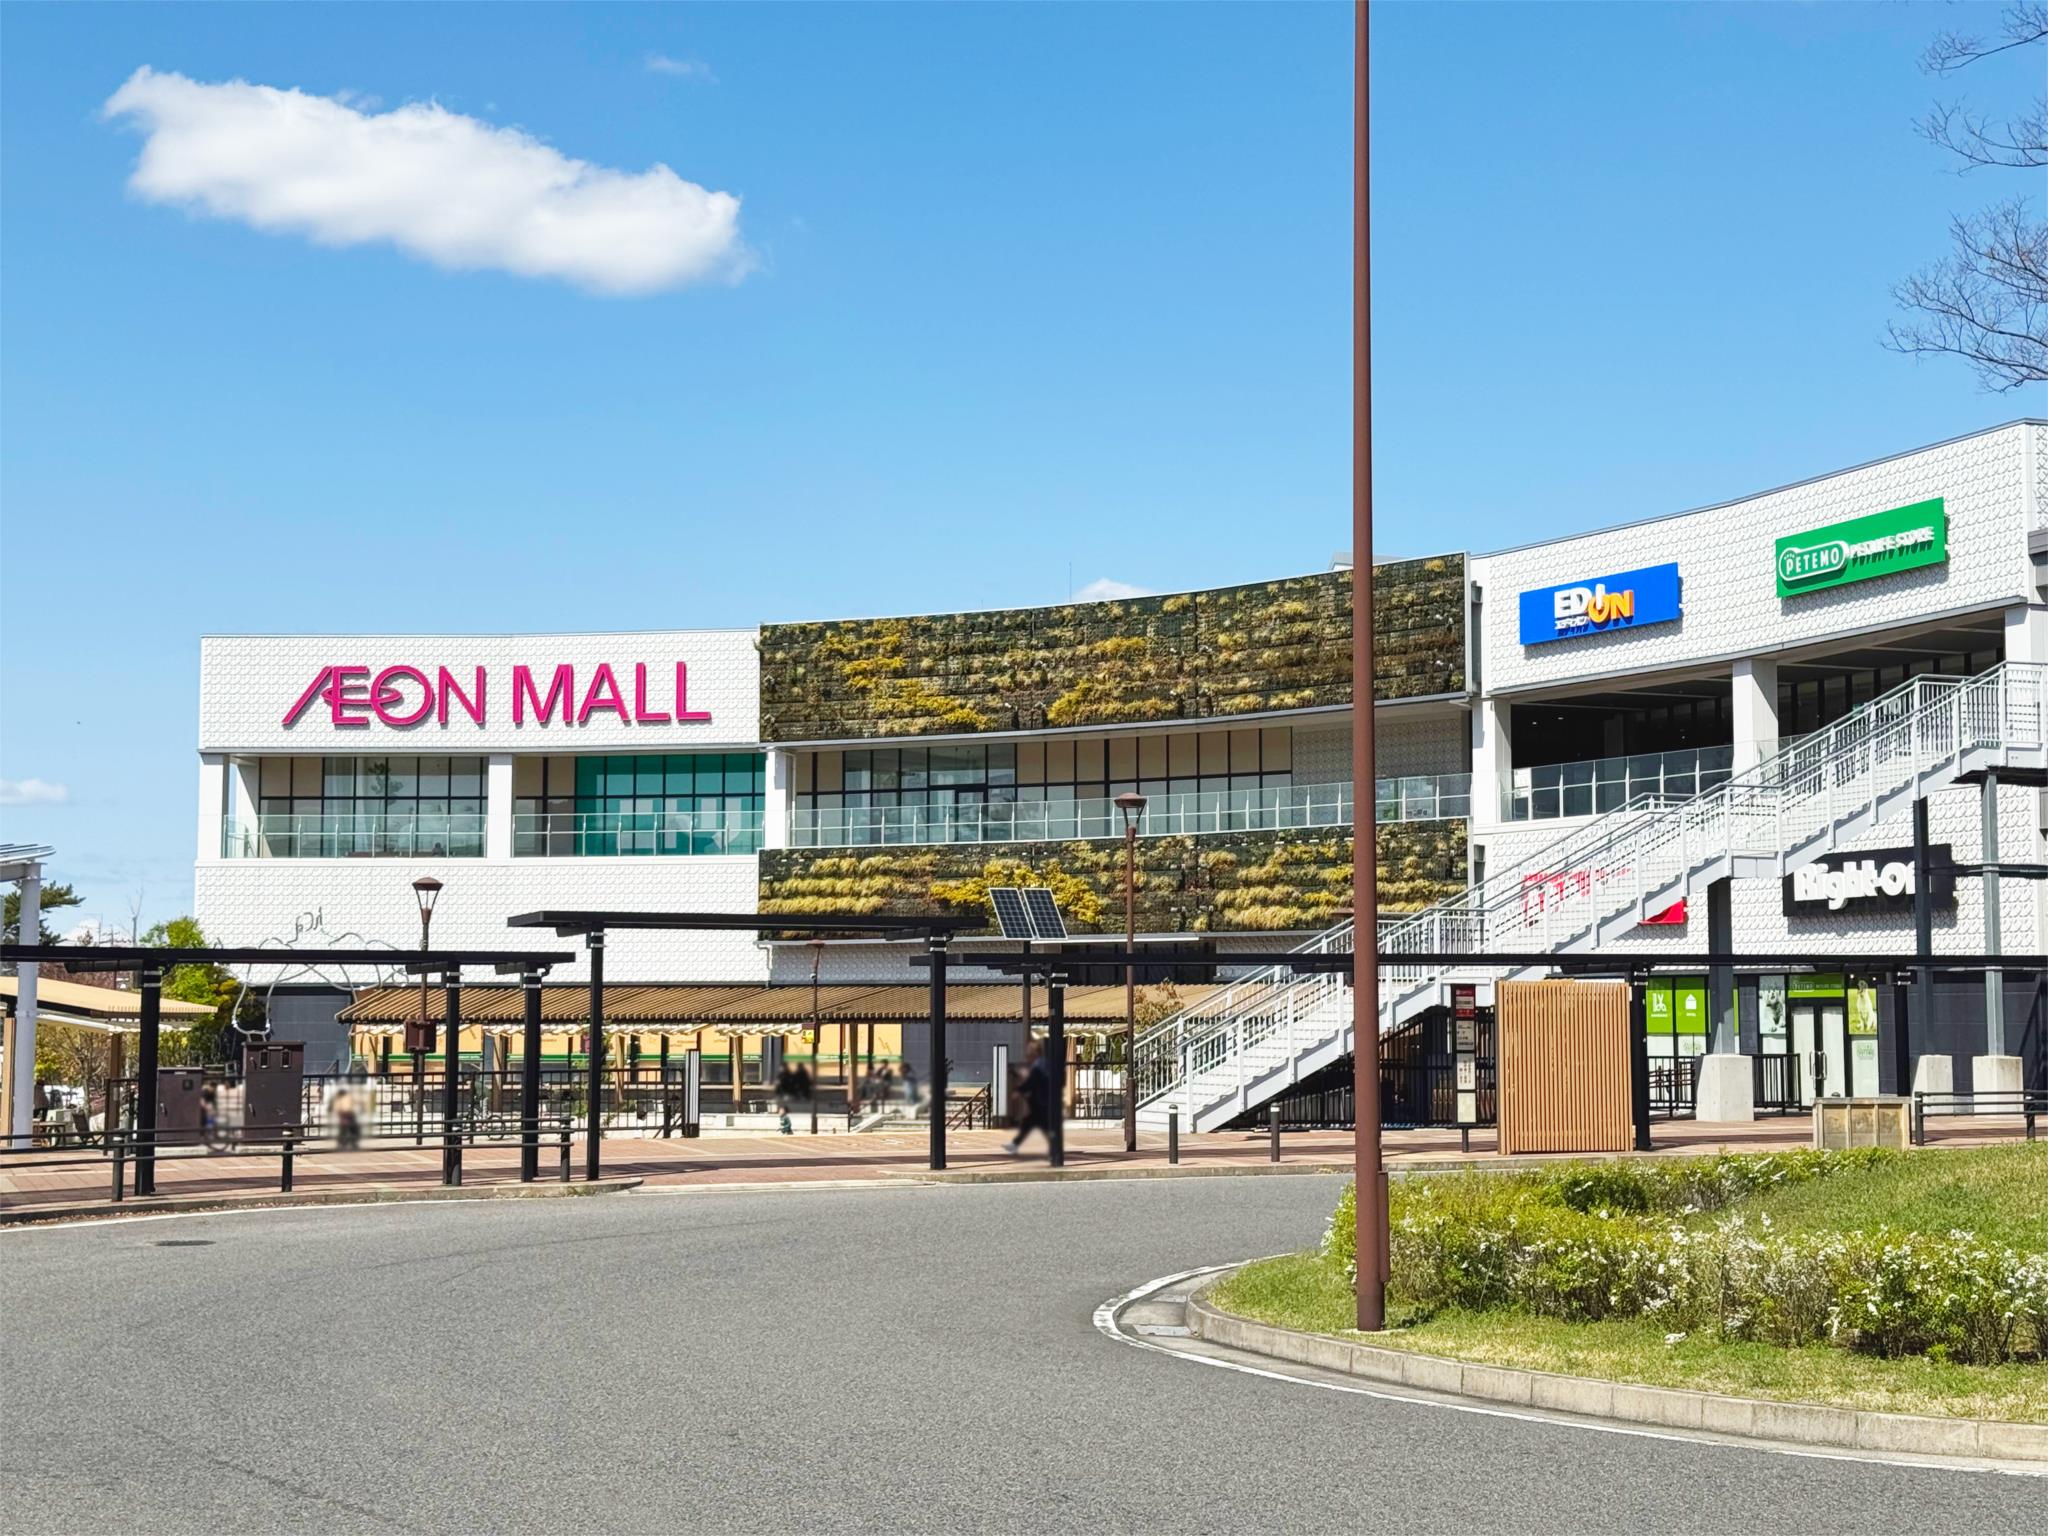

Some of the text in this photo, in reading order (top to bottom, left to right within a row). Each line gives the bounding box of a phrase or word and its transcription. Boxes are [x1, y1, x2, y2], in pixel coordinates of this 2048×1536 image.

[1785, 547, 1840, 576] PETEMO
[1554, 584, 1634, 623] EDION
[513, 661, 712, 723] MALL
